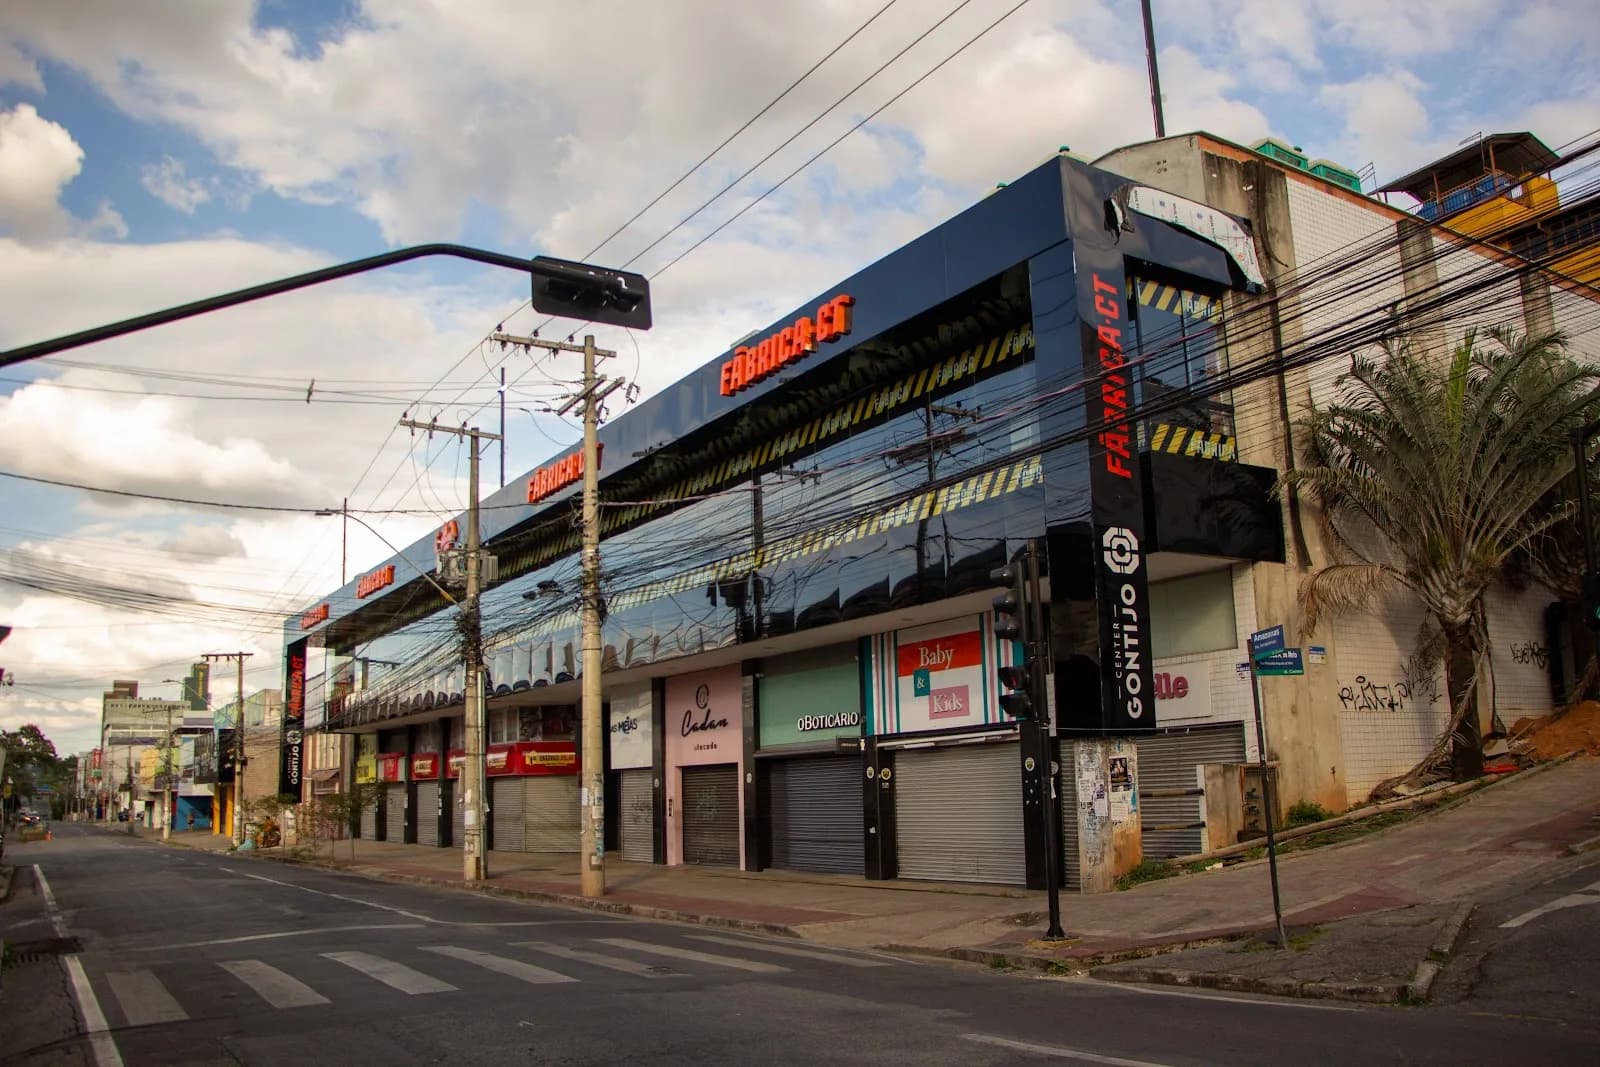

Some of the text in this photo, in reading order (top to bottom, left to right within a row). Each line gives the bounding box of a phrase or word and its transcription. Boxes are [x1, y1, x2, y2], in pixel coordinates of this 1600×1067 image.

[918, 643, 955, 670] Baby
[1110, 583, 1142, 719] GONTIJO
[1113, 622, 1122, 679] CENTER
[916, 676, 926, 689] &
[1152, 672, 1189, 700] lle
[933, 692, 963, 714] Kids
